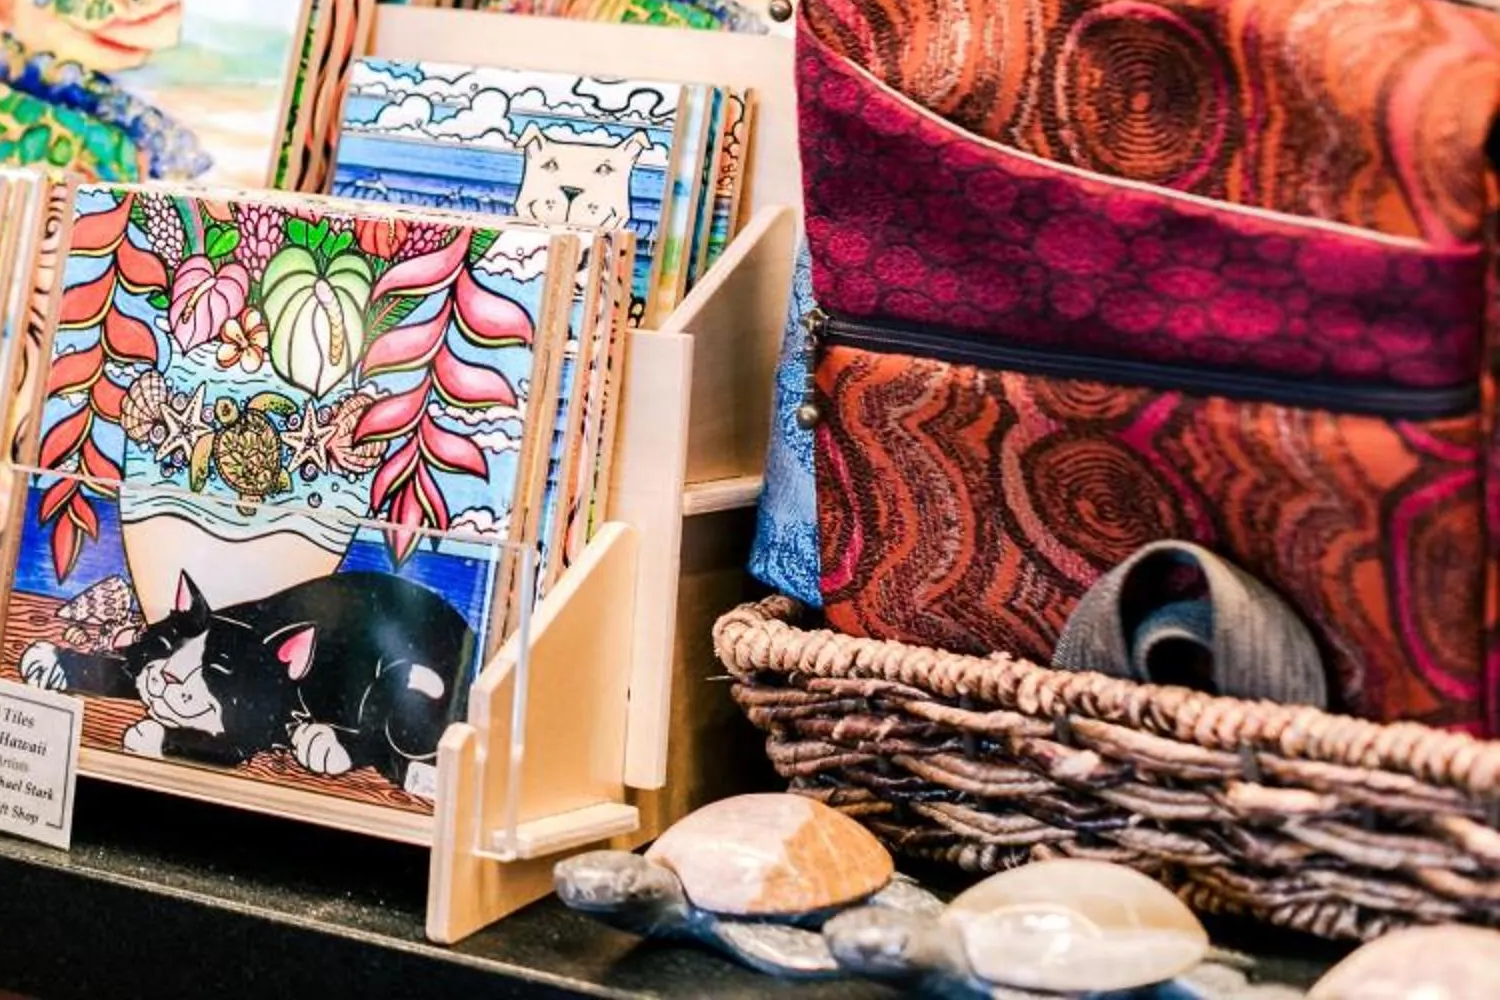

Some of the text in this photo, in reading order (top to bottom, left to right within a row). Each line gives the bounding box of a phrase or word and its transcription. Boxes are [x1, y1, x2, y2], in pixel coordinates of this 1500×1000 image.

[3, 707, 35, 728] Tiles
[0, 731, 46, 756] Hawaii
[25, 782, 53, 800] Stark
[12, 805, 39, 826] Shop
